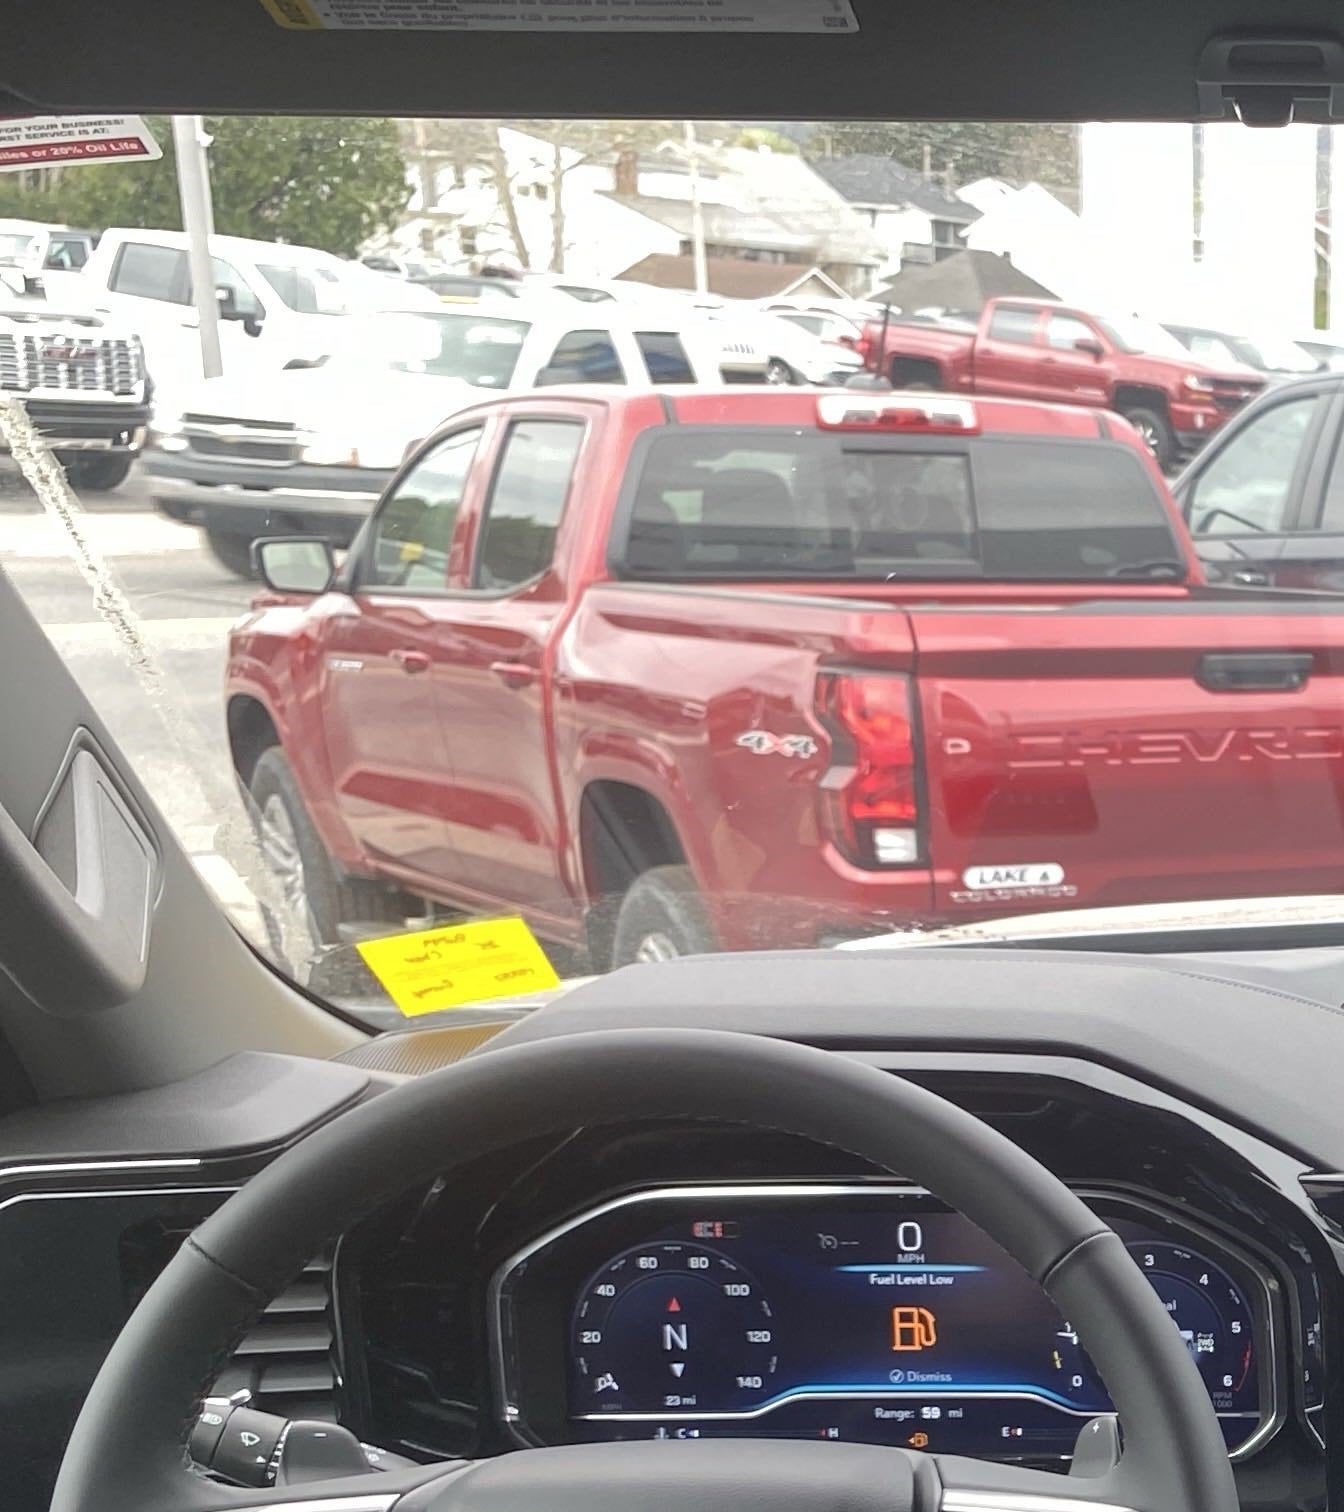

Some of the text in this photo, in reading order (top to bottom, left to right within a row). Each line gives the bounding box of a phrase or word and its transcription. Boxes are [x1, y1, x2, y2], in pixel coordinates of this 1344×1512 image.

[979, 869, 1028, 884] LAKE
[898, 1222, 921, 1251] 0
[637, 1257, 658, 1269] 60
[688, 1257, 710, 1269] 80
[897, 1253, 925, 1263] MPH
[1145, 1255, 1154, 1266] 3
[869, 1273, 953, 1285] Fuel Level Low
[1199, 1274, 1209, 1285] 4
[595, 1284, 616, 1297] 40
[723, 1284, 750, 1297] 100
[1231, 1322, 1242, 1333] 5
[580, 1331, 601, 1343] 20
[664, 1324, 687, 1350] N
[747, 1331, 771, 1343] 120
[736, 1376, 762, 1388] 140
[907, 1371, 952, 1382] Dismiss
[1072, 1376, 1083, 1387] 0
[1223, 1376, 1233, 1387] 6
[664, 1395, 696, 1406] 23 mi
[875, 1407, 963, 1421] Range: 59 mi
